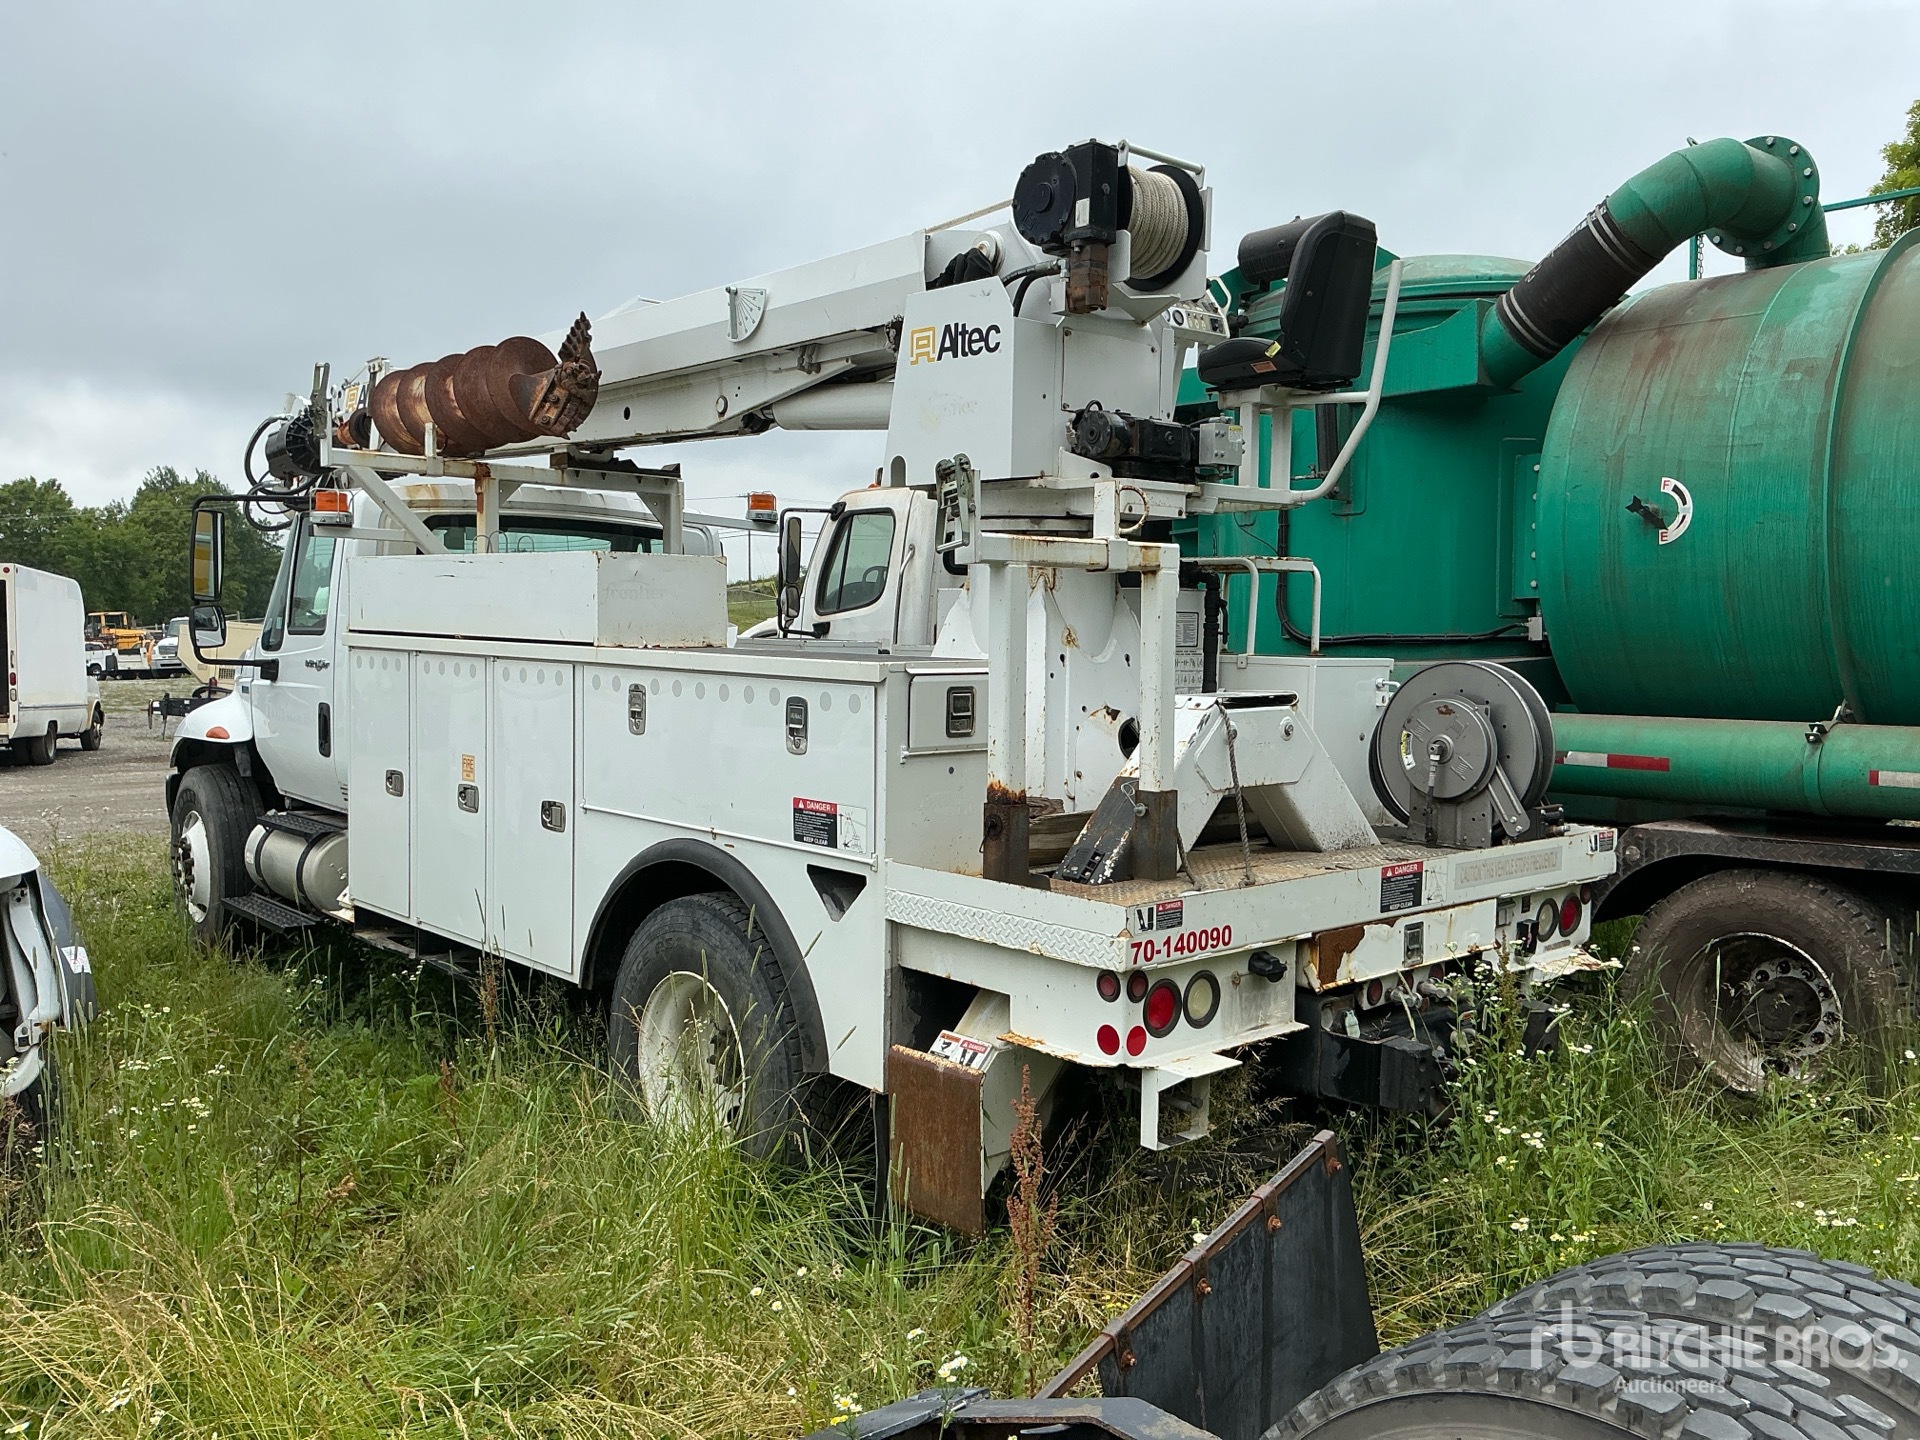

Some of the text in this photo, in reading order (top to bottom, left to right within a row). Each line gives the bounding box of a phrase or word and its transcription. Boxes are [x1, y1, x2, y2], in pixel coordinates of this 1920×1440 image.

[936, 322, 1001, 362] Altec
[1662, 479, 1671, 490] F
[1660, 531, 1669, 542] E
[806, 800, 831, 812] DANGER
[1394, 863, 1418, 875] DANGER
[1130, 924, 1232, 965] 70-140090
